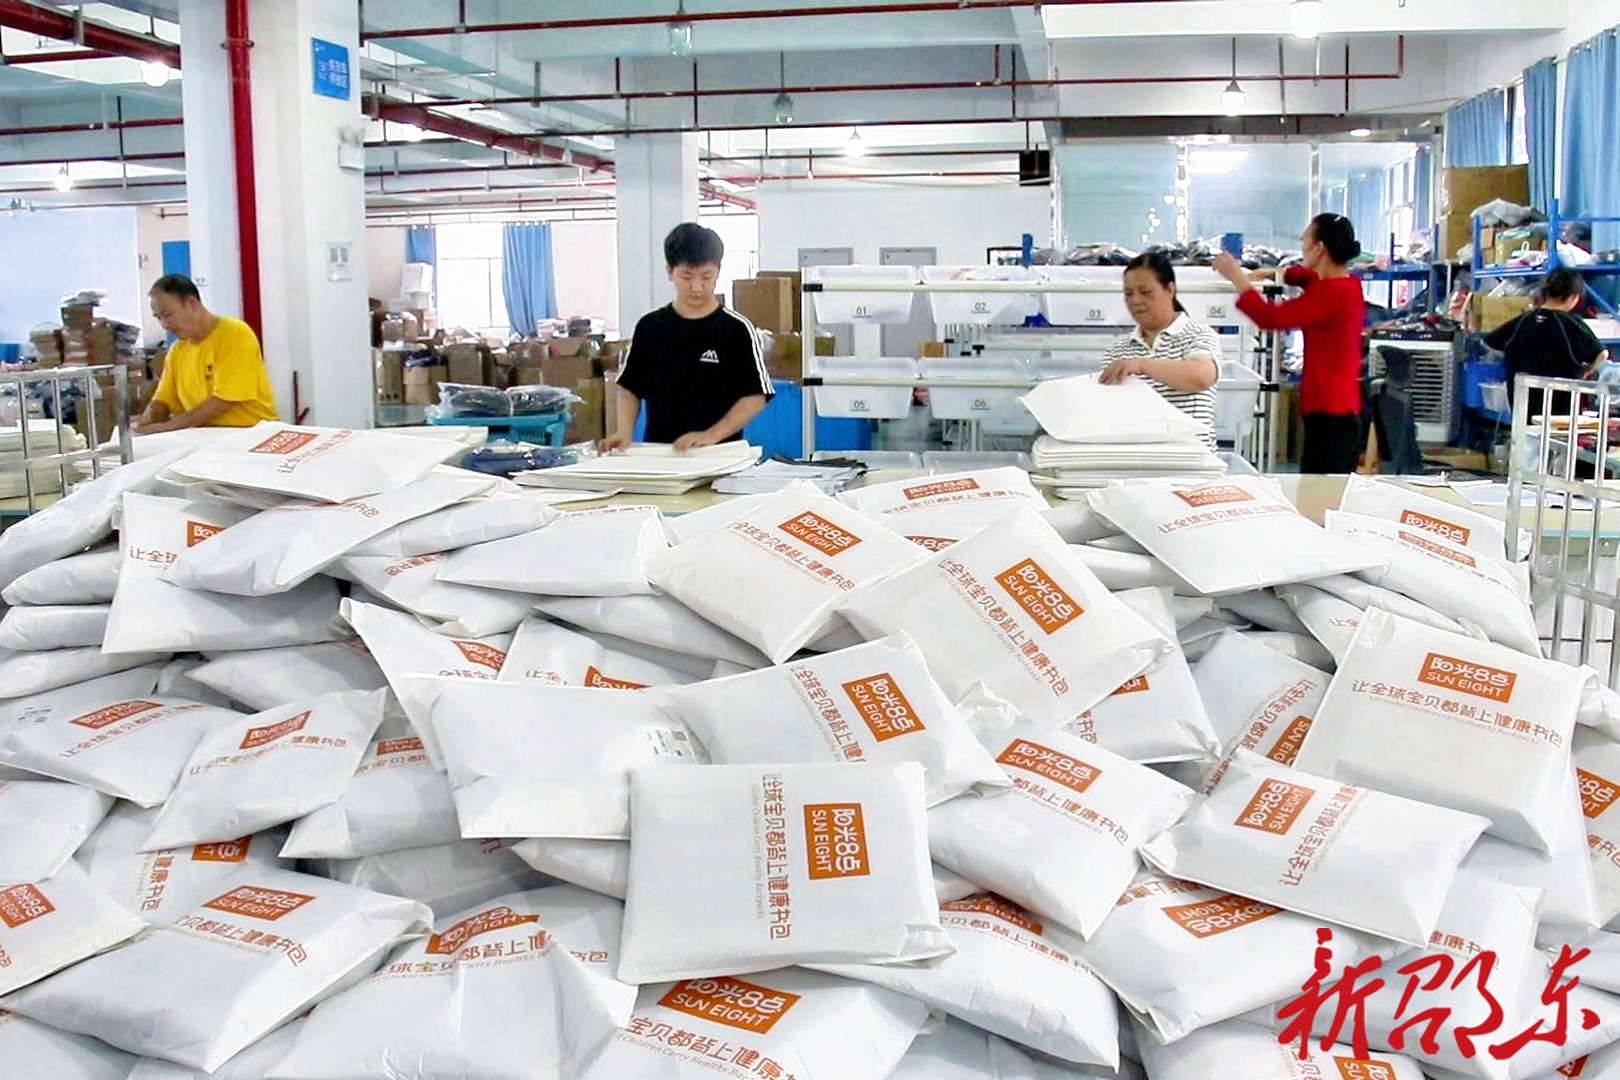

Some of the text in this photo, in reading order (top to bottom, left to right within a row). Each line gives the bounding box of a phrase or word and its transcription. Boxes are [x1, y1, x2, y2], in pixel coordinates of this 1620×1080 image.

[787, 523, 839, 552] SUN EIGHT
[797, 514, 854, 547] 阳光8点
[1003, 575, 1027, 597] SUN
[1022, 593, 1059, 626] EIGHT
[1018, 564, 1076, 621] 阳光8点
[1426, 671, 1505, 698] SUN EIGHT
[1430, 656, 1510, 687] 阳光8点
[789, 666, 867, 763] 全球宝贝都背上健
[851, 684, 893, 733] SUN EIGHT
[866, 678, 915, 731] 阳光8点
[1351, 679, 1563, 748] 让全球宝贝都背上健康书包
[1288, 720, 1311, 743] SUN
[1005, 754, 1084, 786] SUN EIGHT
[1012, 743, 1092, 780] 阳光8点
[1008, 774, 1129, 847] 都背上健康书包
[1242, 782, 1291, 826] 阳光8点
[1268, 787, 1305, 830] SUN EIGHT
[811, 809, 833, 872] SUN EIGHT
[831, 808, 862, 875] 阳光8点
[1278, 783, 1359, 887] 让全球宝贝都背上健康
[213, 898, 286, 917] SUN EIGHT
[231, 887, 304, 909] 阳光8点
[1176, 903, 1225, 921] EIGHT
[671, 993, 769, 1026] SUN EIGHT
[684, 979, 787, 1014] 阳光8点
